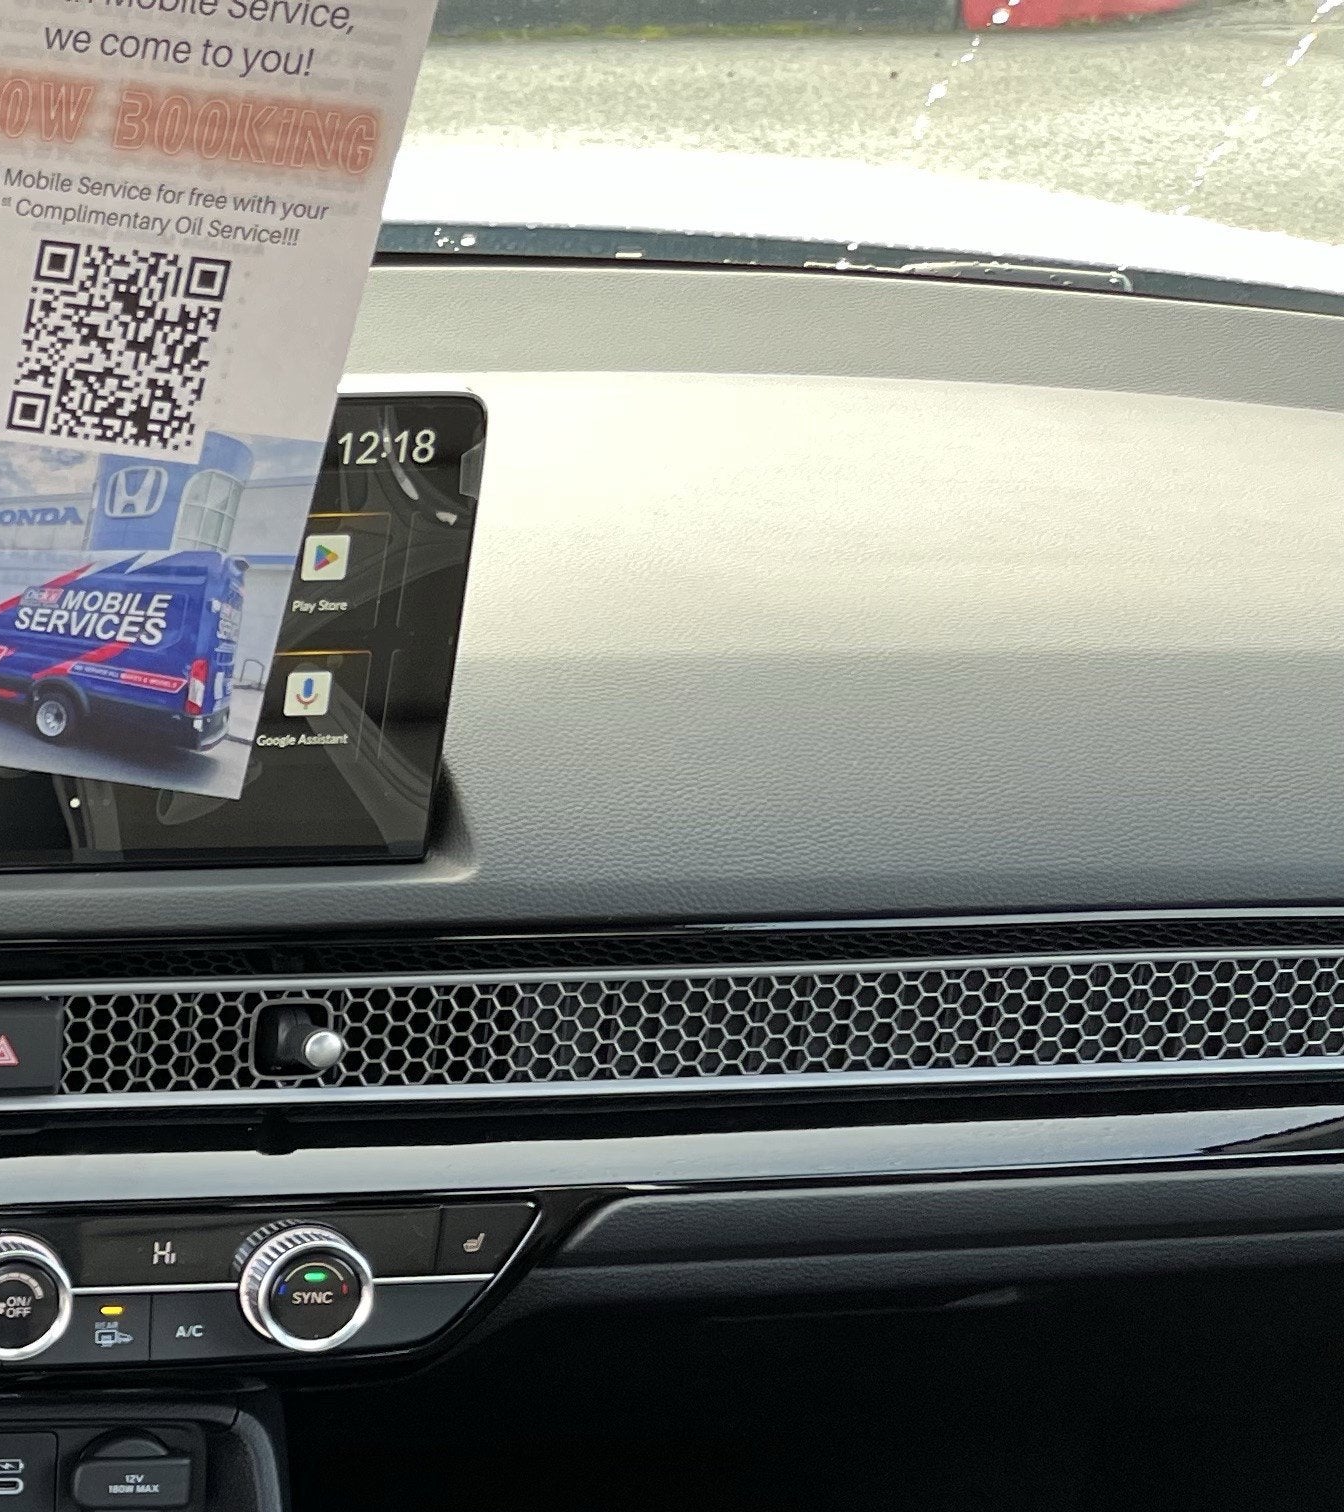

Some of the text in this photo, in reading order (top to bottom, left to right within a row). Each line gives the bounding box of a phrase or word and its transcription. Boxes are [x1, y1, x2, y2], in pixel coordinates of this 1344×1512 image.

[227, 0, 354, 34] Service,
[45, 26, 314, 77] we come to you!
[4, 168, 74, 193] Mobile
[77, 176, 151, 202] Service
[156, 184, 184, 205] for
[188, 187, 227, 211] free
[232, 193, 276, 215] with
[280, 201, 330, 221] your
[15, 199, 171, 236] Complimentary
[175, 216, 203, 234] Oil
[207, 219, 300, 247] Service!!!
[337, 430, 436, 466] 12:18
[62, 590, 173, 618] MOBILE
[292, 600, 348, 613] Play Store
[14, 607, 167, 646] SERVICES
[256, 733, 349, 748] Google Assistant
[6, 1296, 32, 1307] ON/
[291, 1291, 333, 1305] SYNC
[5, 1307, 32, 1318] OFF
[175, 1324, 204, 1339] A/C
[125, 1474, 145, 1484] 12V
[136, 1484, 160, 1493] MAX
